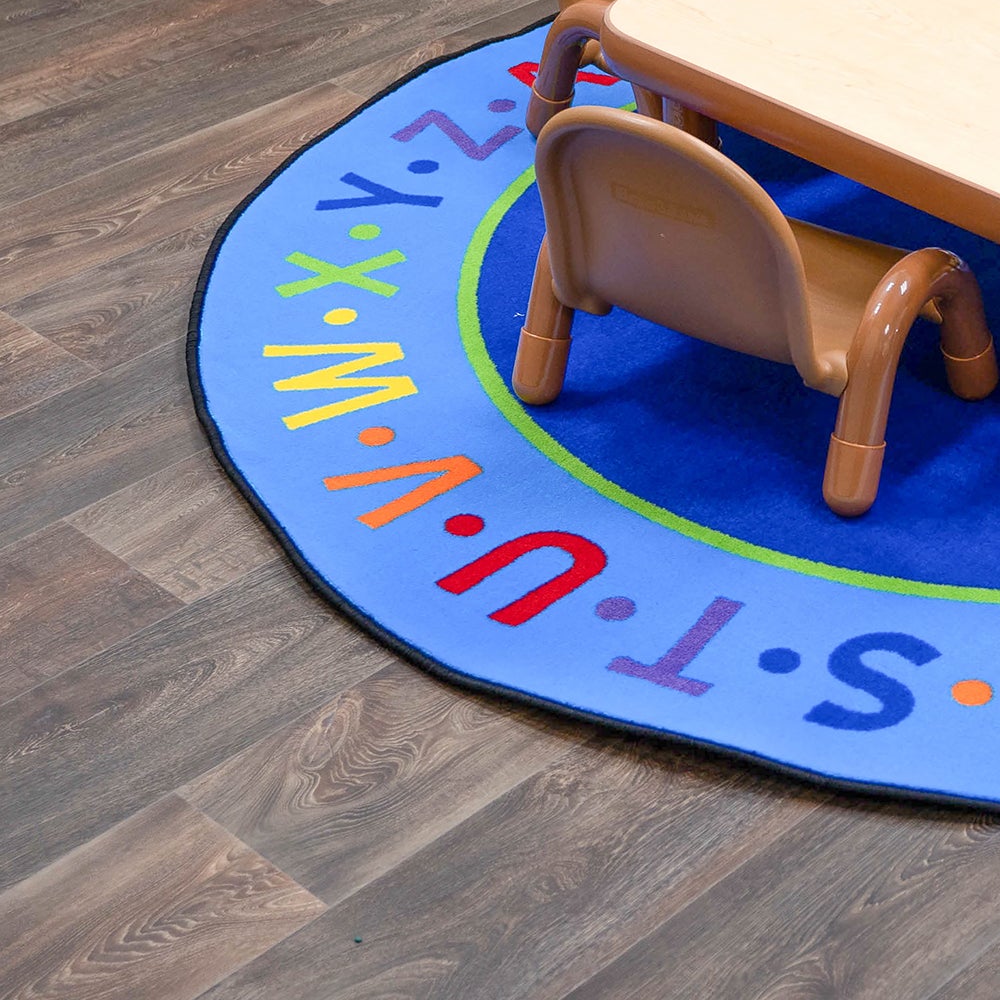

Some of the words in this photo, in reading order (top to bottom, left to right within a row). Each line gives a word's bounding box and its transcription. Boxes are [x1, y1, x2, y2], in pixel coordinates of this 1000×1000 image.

[390, 109, 524, 161] Z
[315, 172, 444, 211] Y
[275, 248, 407, 299] X
[262, 341, 418, 430] W
[323, 454, 483, 529] V
[436, 530, 607, 627] U
[606, 595, 745, 697] T
[802, 631, 942, 731] S
